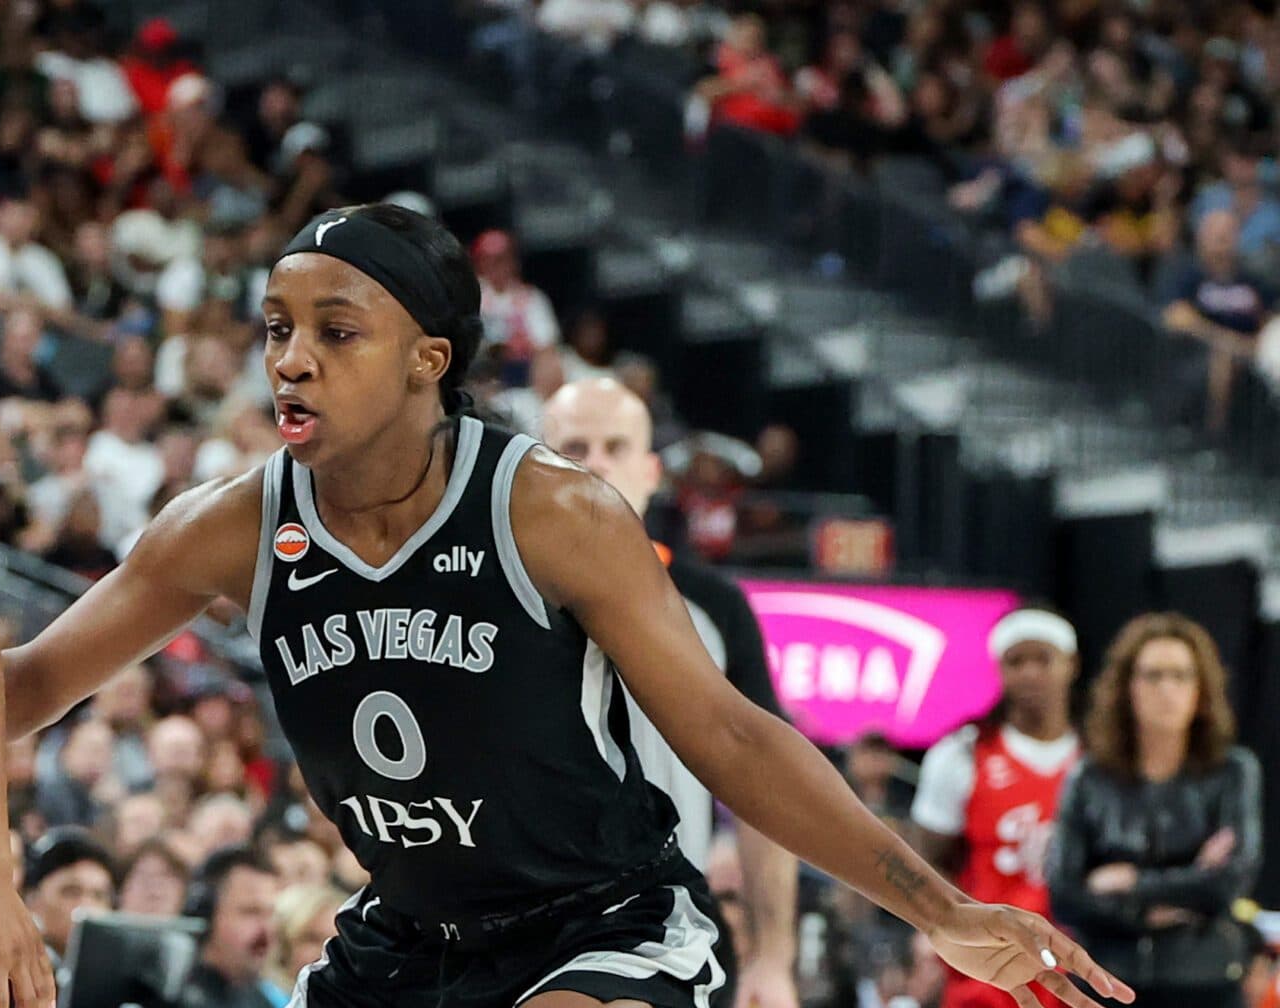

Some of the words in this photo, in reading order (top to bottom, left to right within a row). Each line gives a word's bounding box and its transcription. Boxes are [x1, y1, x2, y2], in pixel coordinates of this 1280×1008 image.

[432, 546, 485, 577] ally
[275, 614, 356, 686] LAS
[357, 608, 499, 673] VEGAS
[353, 690, 426, 781] 0
[340, 795, 484, 848] IPSY
